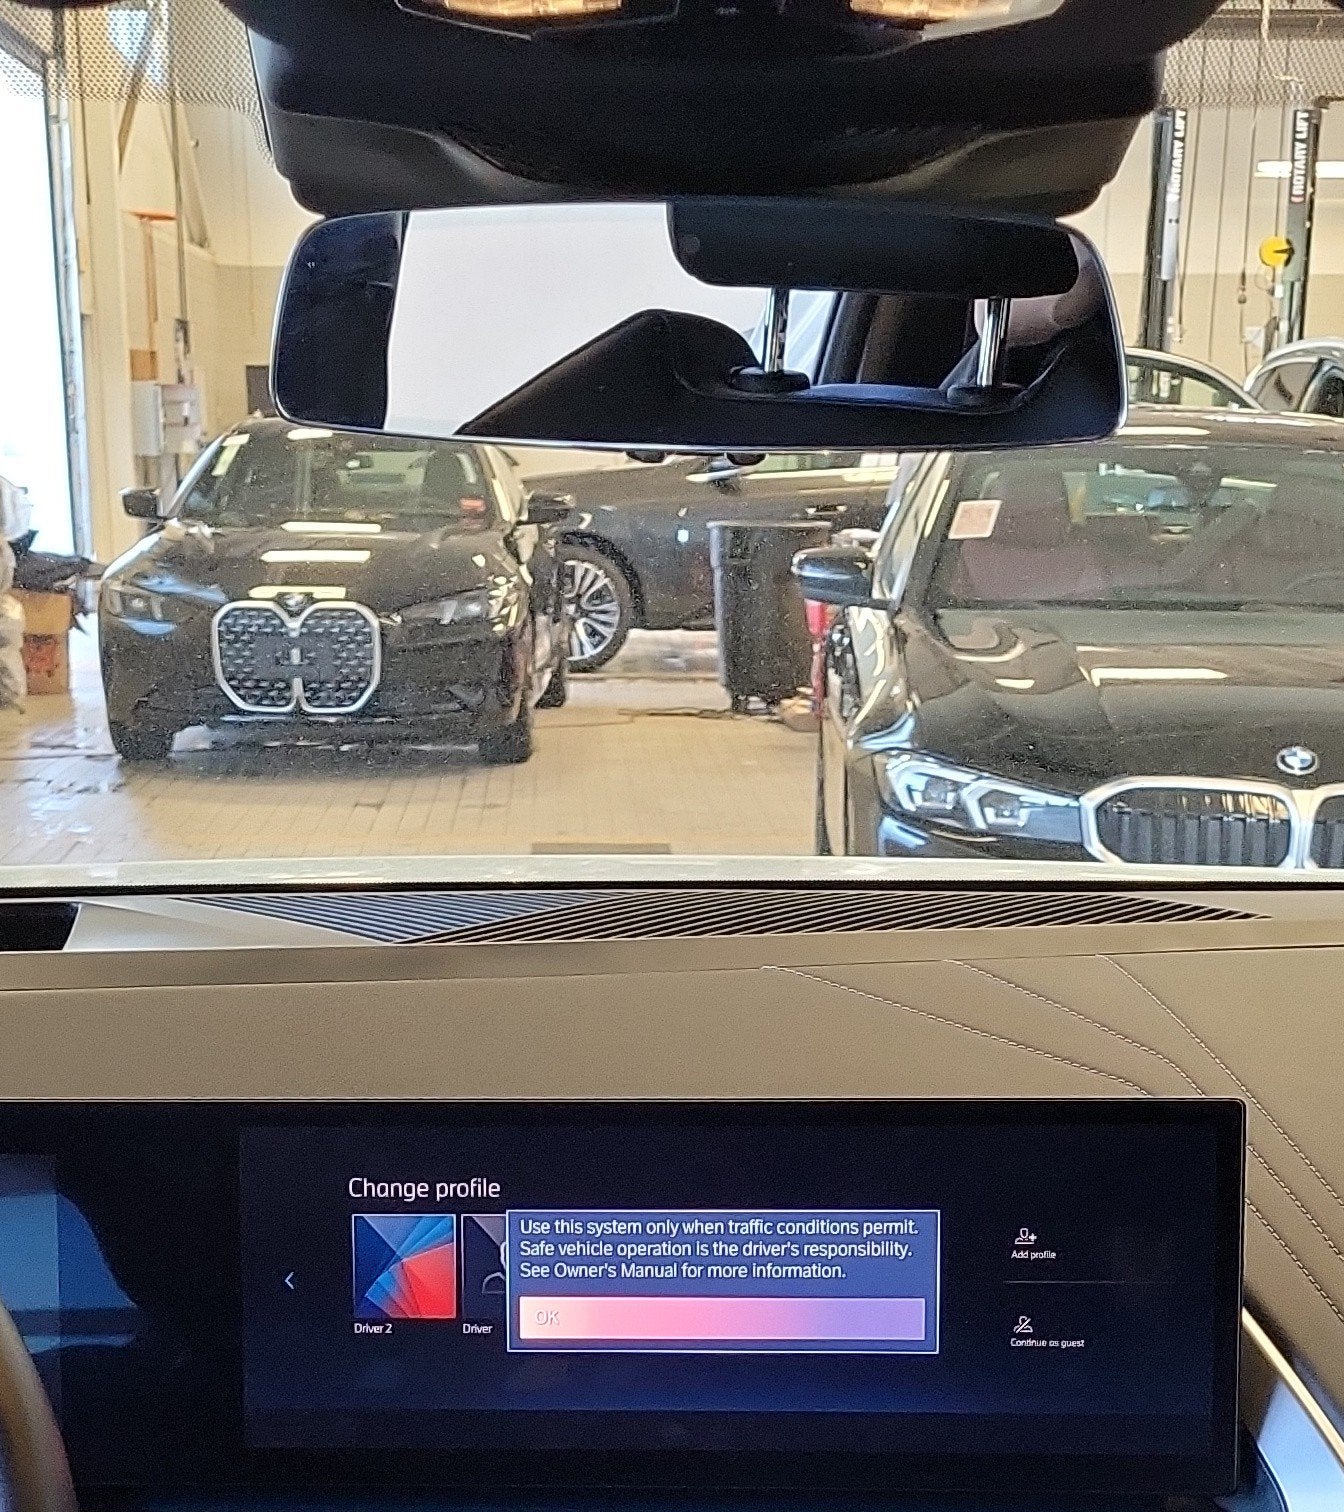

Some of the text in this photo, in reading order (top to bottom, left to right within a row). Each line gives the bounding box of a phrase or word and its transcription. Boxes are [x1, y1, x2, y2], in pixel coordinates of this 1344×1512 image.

[1174, 110, 1186, 138] LIFT
[1292, 111, 1309, 195] ROTARY LIFT
[348, 1178, 501, 1202] Change profile
[520, 1219, 919, 1238] Use this system only when traffic conditions permit.
[520, 1241, 913, 1260] Safe vehicle operation is the driver's responsibility.
[1011, 1250, 1057, 1261] Add profile
[520, 1262, 846, 1278] See Owner's Manual for more information.
[536, 1310, 559, 1326] OK
[354, 1323, 393, 1334] Driver 2
[462, 1323, 493, 1334] Driver
[1010, 1337, 1047, 1347] Continue
[1061, 1339, 1085, 1349] guest
